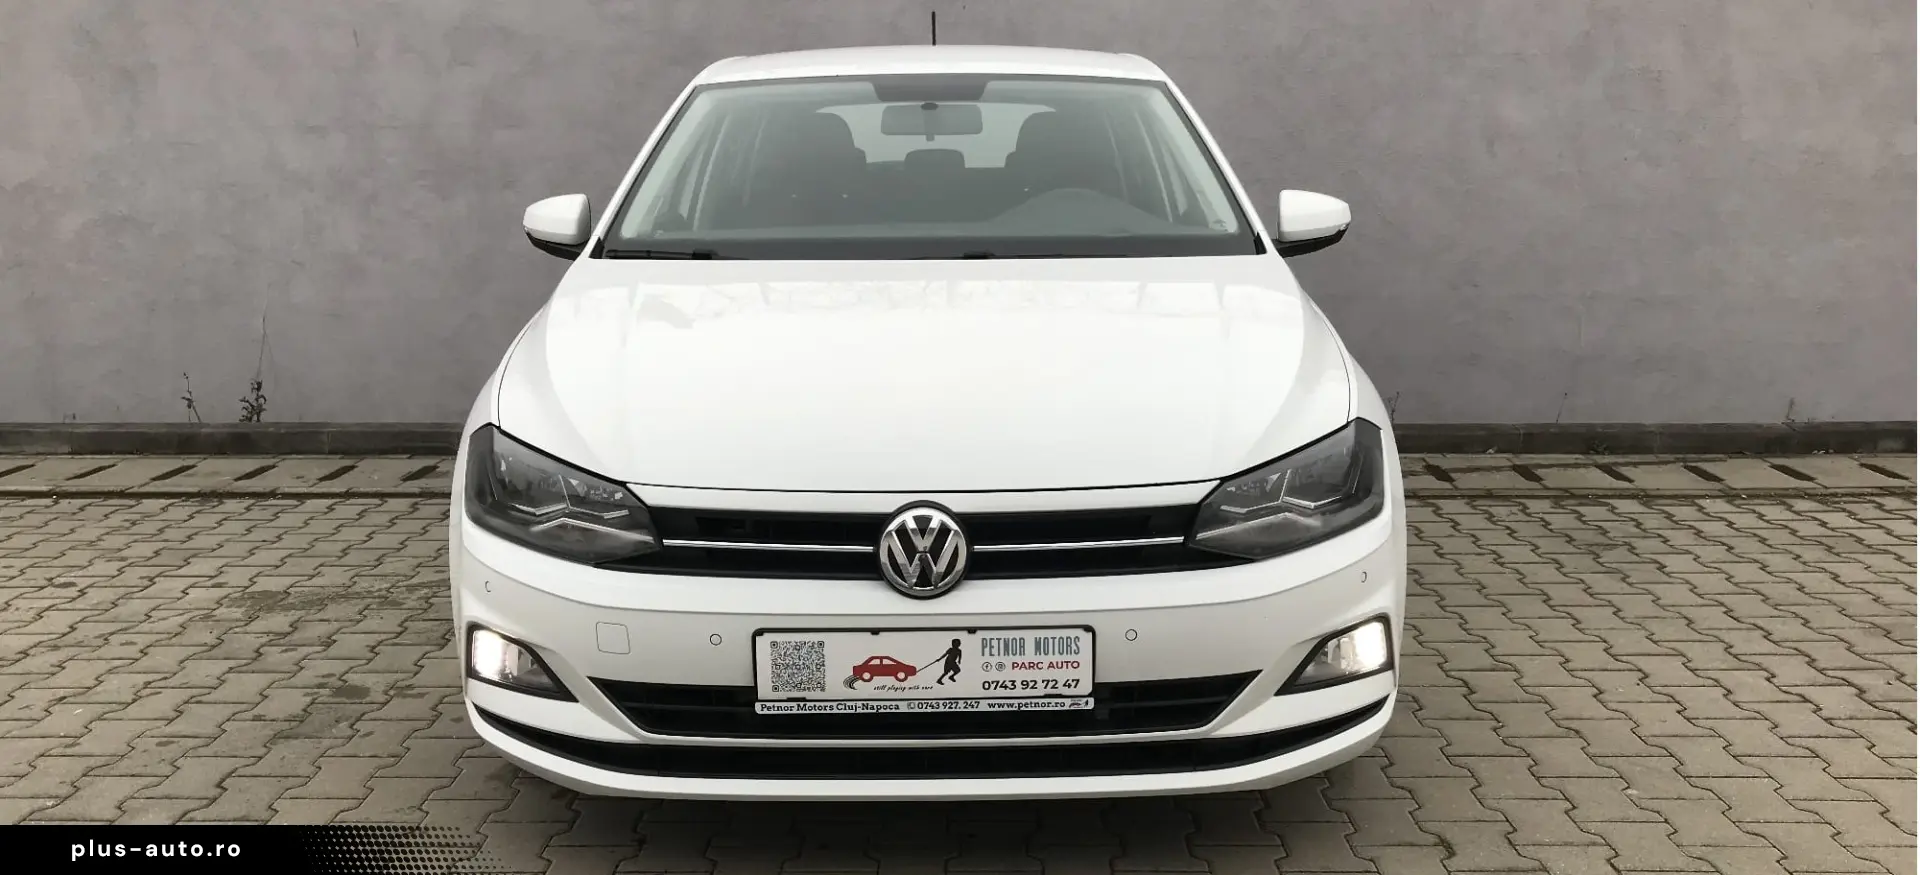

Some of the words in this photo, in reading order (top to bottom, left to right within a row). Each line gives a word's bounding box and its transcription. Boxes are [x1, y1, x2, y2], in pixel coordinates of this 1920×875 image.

[981, 637, 1026, 657] PETNOR
[1034, 636, 1081, 656] MOTORS
[1011, 661, 1044, 670] PARC
[1047, 660, 1081, 670] AUTO
[982, 680, 1017, 691] 0743
[1020, 679, 1038, 690] 92
[1041, 679, 1059, 690] 72
[1062, 678, 1081, 689] 47
[760, 703, 795, 712] Petnor
[796, 702, 834, 712] Motors
[835, 702, 900, 713] Cluj-Napoca
[917, 701, 940, 710] 0743
[963, 701, 981, 709] 247
[987, 700, 1066, 711] www.petnor.ro
